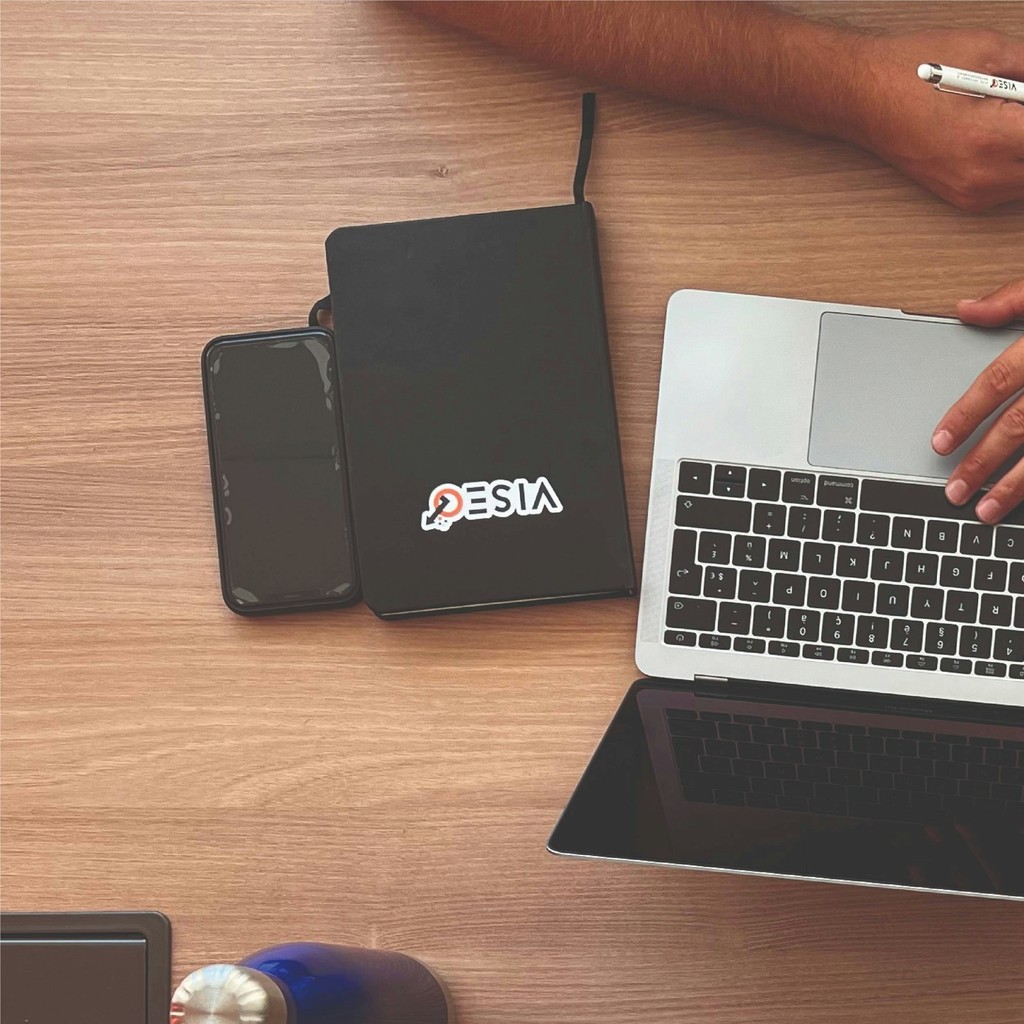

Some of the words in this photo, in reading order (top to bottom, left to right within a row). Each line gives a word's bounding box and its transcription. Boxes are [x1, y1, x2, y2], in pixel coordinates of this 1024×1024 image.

[823, 480, 854, 488] command
[904, 529, 911, 538] N
[938, 532, 946, 541] B
[972, 535, 980, 544] V
[1007, 538, 1014, 548] C
[780, 551, 788, 560] M
[816, 554, 822, 563] L
[850, 558, 856, 566] K
[884, 561, 890, 570] J
[917, 564, 926, 573] H
[952, 567, 960, 577] G
[718, 572, 724, 581] $
[987, 571, 993, 580] F
[786, 586, 793, 594] P
[820, 589, 828, 598] O
[889, 596, 896, 605] U
[924, 599, 930, 608] Y
[958, 603, 964, 612] T
[992, 606, 999, 615] R
[799, 626, 806, 636] 0
[834, 630, 841, 639] 9
[868, 634, 875, 643] 8
[903, 638, 908, 646] 7
[937, 640, 944, 649] 6
[971, 643, 978, 653] 5
[1006, 647, 1013, 656] 4
